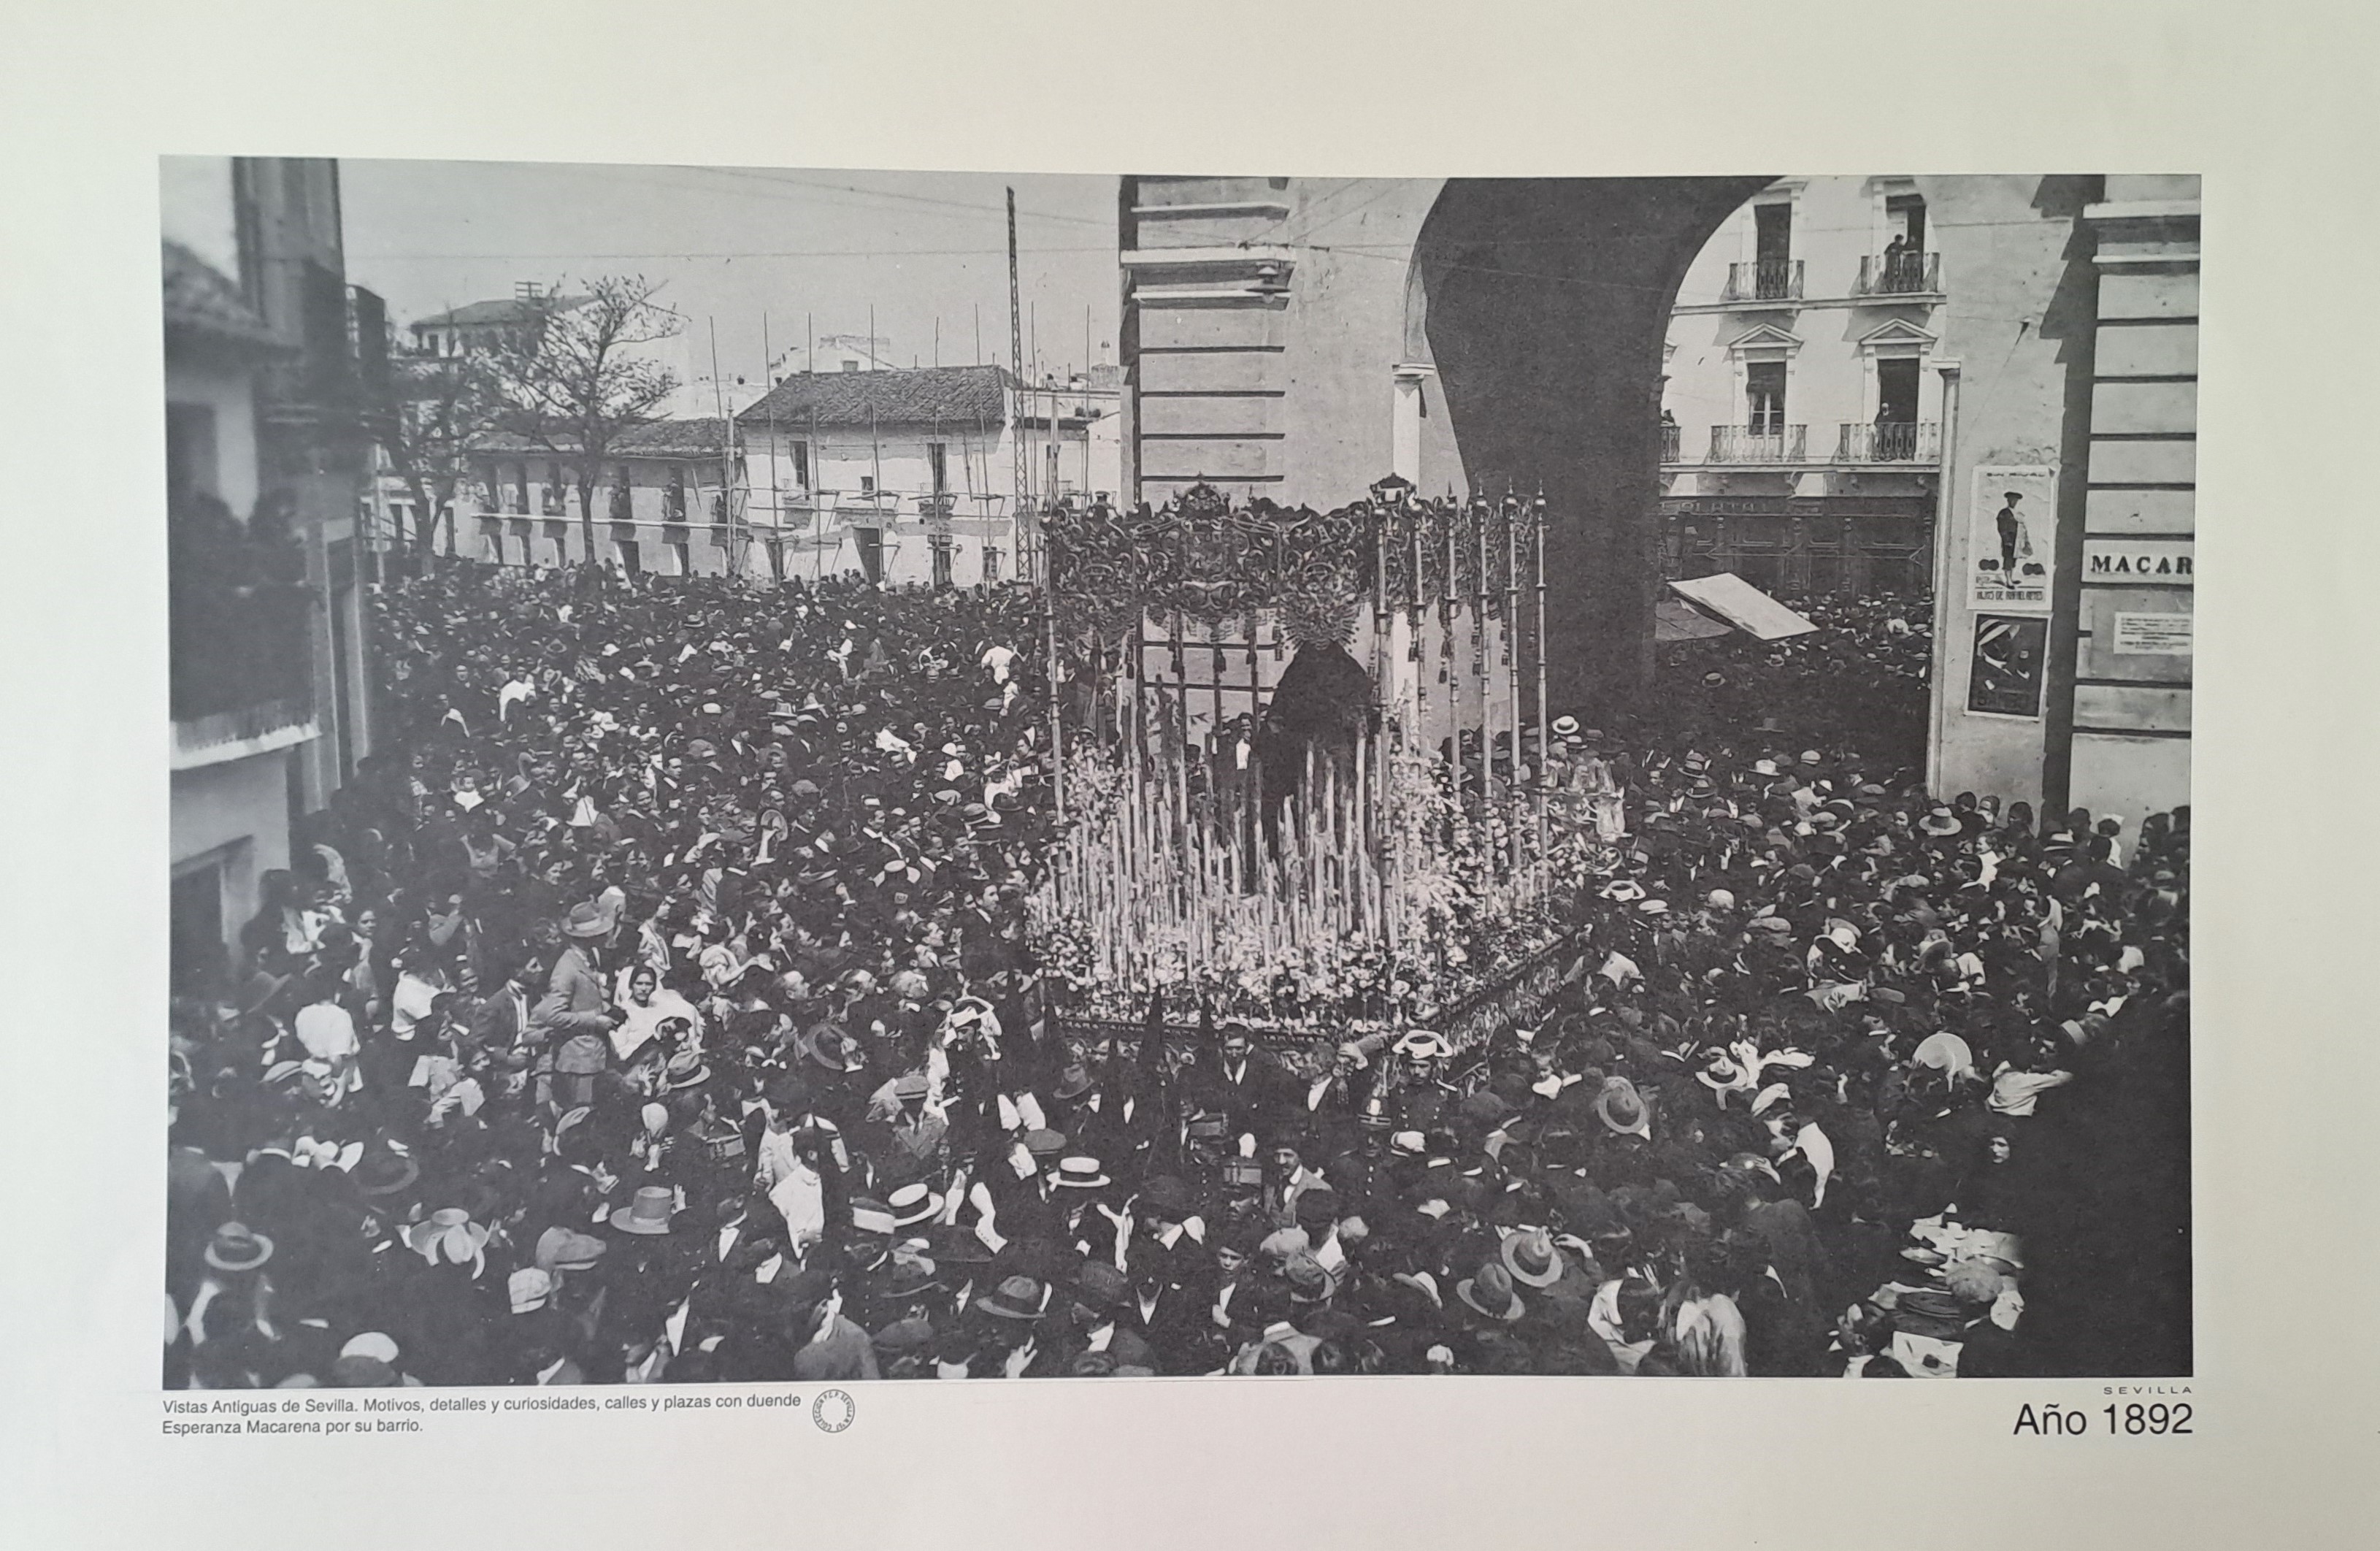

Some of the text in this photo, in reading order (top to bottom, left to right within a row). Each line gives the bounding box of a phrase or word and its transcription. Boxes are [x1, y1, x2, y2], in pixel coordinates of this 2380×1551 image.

[2090, 555, 2192, 575] MACAR
[2103, 1386, 2192, 1395] SEVILLA
[163, 1393, 801, 1416] Vistas Antiguas de Sevilla. Motivos, detalles y curiosidades, calles y plazas con duende
[162, 1419, 423, 1436] Esperanza Macarena por su barrio.
[2013, 1403, 2193, 1435] Año 1892
